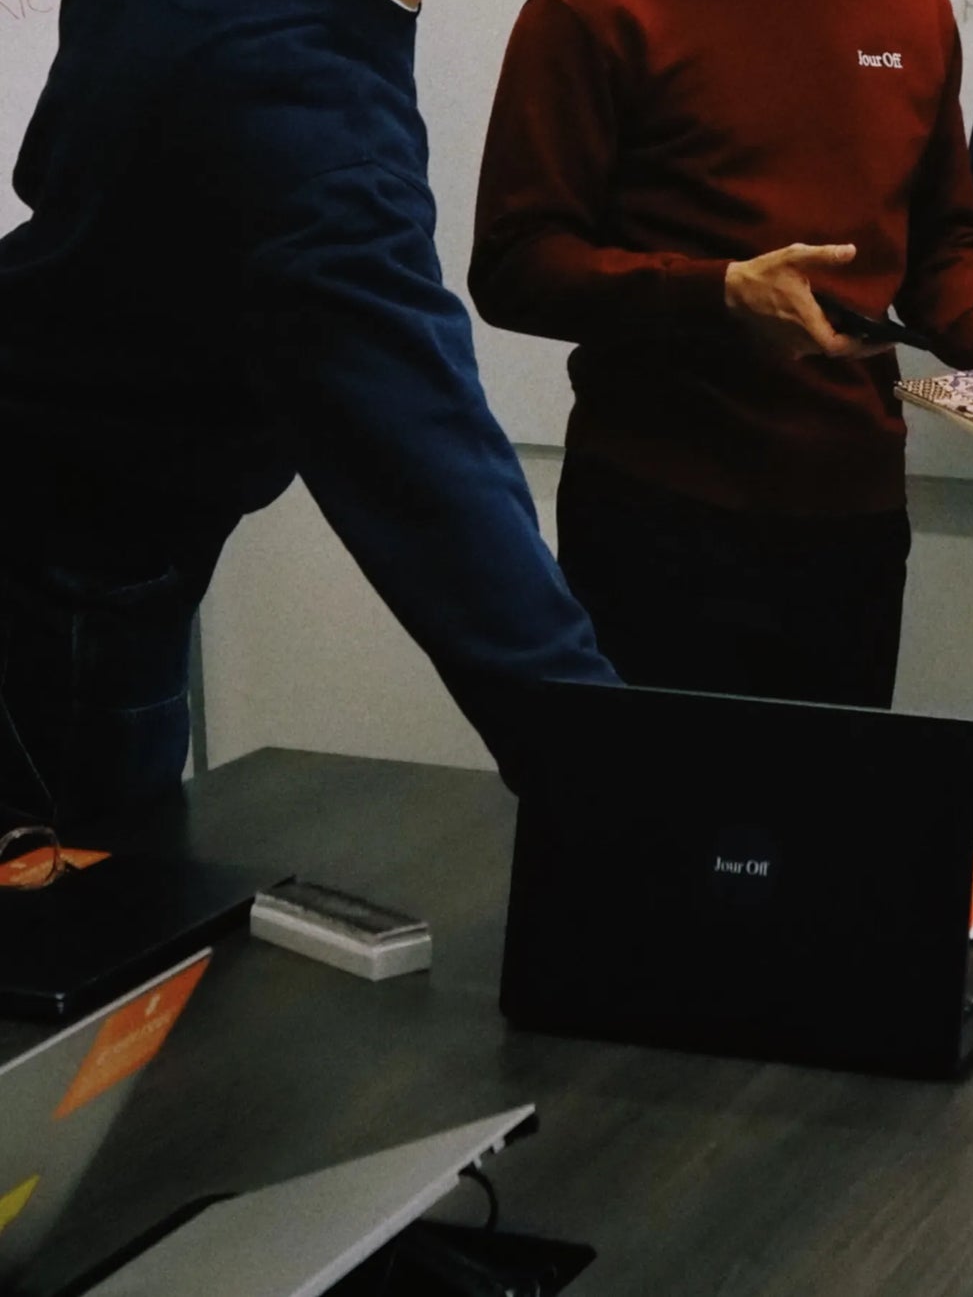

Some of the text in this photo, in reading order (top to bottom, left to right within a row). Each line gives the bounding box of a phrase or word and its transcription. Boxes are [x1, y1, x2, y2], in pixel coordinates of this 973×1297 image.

[857, 49, 903, 69] Jour Off
[714, 856, 771, 877] Jour Off
